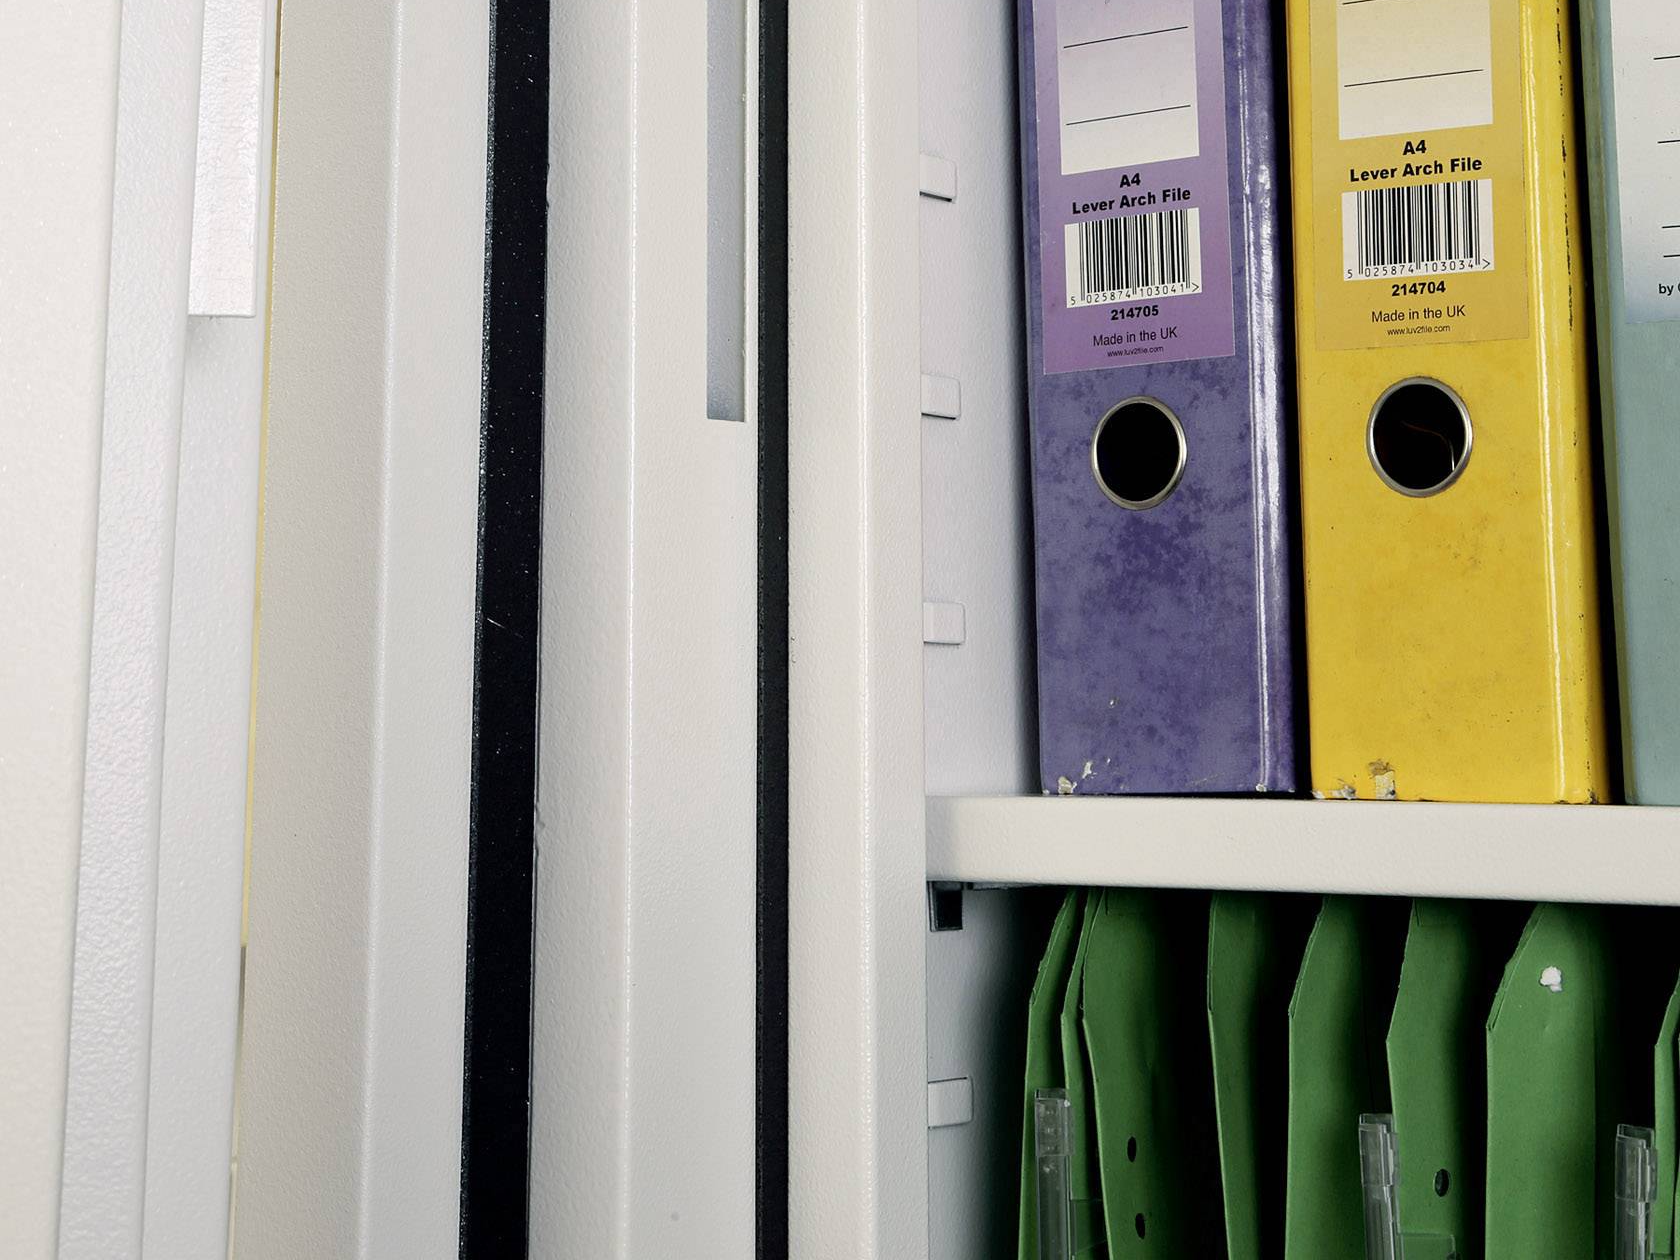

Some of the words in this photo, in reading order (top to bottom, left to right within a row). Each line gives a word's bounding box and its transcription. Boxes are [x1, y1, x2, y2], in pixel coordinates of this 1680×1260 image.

[1402, 139, 1427, 156] A4
[1350, 166, 1397, 182] Lever
[1402, 160, 1443, 177] Arch
[1450, 157, 1483, 173] File
[1119, 172, 1141, 188] A4
[1072, 199, 1115, 214] Lever
[1119, 191, 1156, 208] Arch
[1162, 187, 1191, 203] File
[1391, 280, 1446, 297] 214704
[1658, 283, 1674, 296] by
[1110, 304, 1159, 321] 214705
[1371, 309, 1405, 323] Made
[1408, 308, 1419, 320] in
[1423, 307, 1442, 319] the
[1446, 304, 1466, 318] UK
[1093, 333, 1123, 347] Made
[1126, 331, 1136, 343] in
[1139, 329, 1157, 342] the
[1160, 326, 1178, 340] UK
